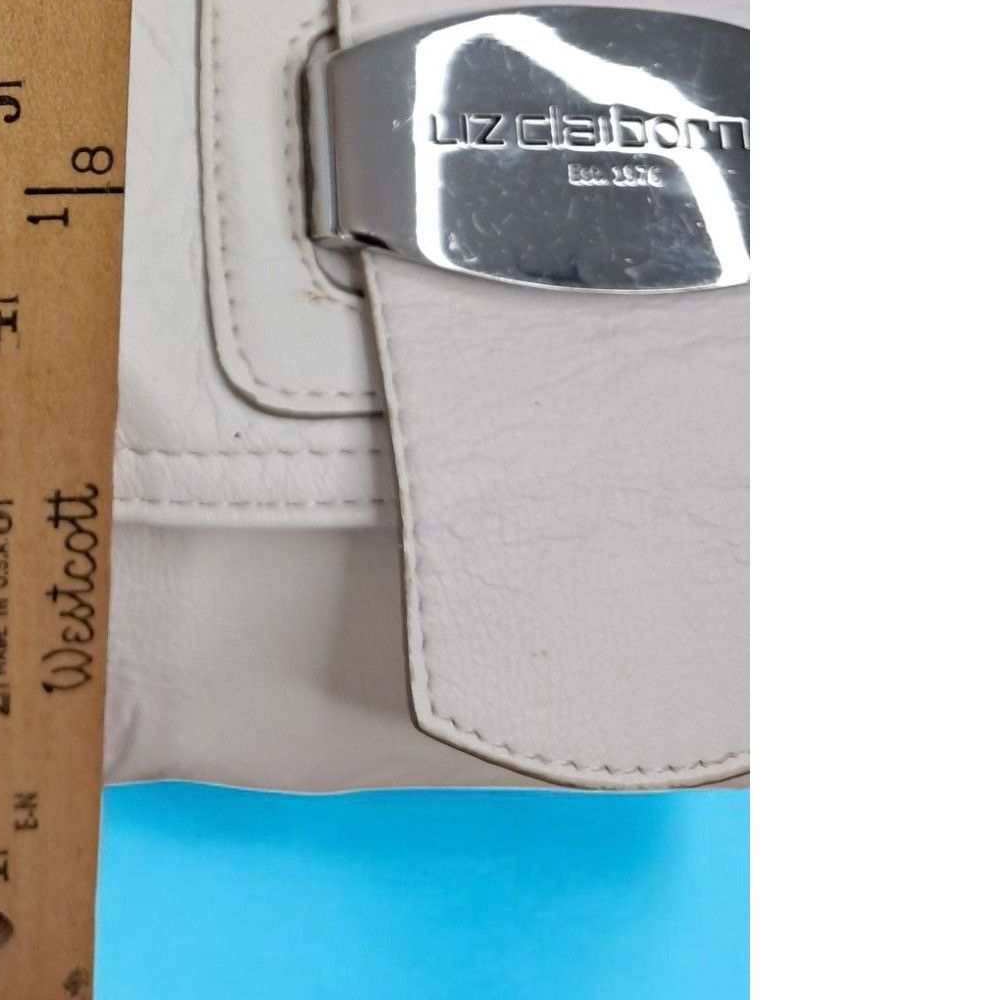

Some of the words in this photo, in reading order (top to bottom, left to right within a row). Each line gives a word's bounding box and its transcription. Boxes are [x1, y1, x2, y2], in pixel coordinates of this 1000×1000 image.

[71, 146, 114, 175] 8
[26, 207, 69, 227] 1
[42, 482, 99, 693] Westcott
